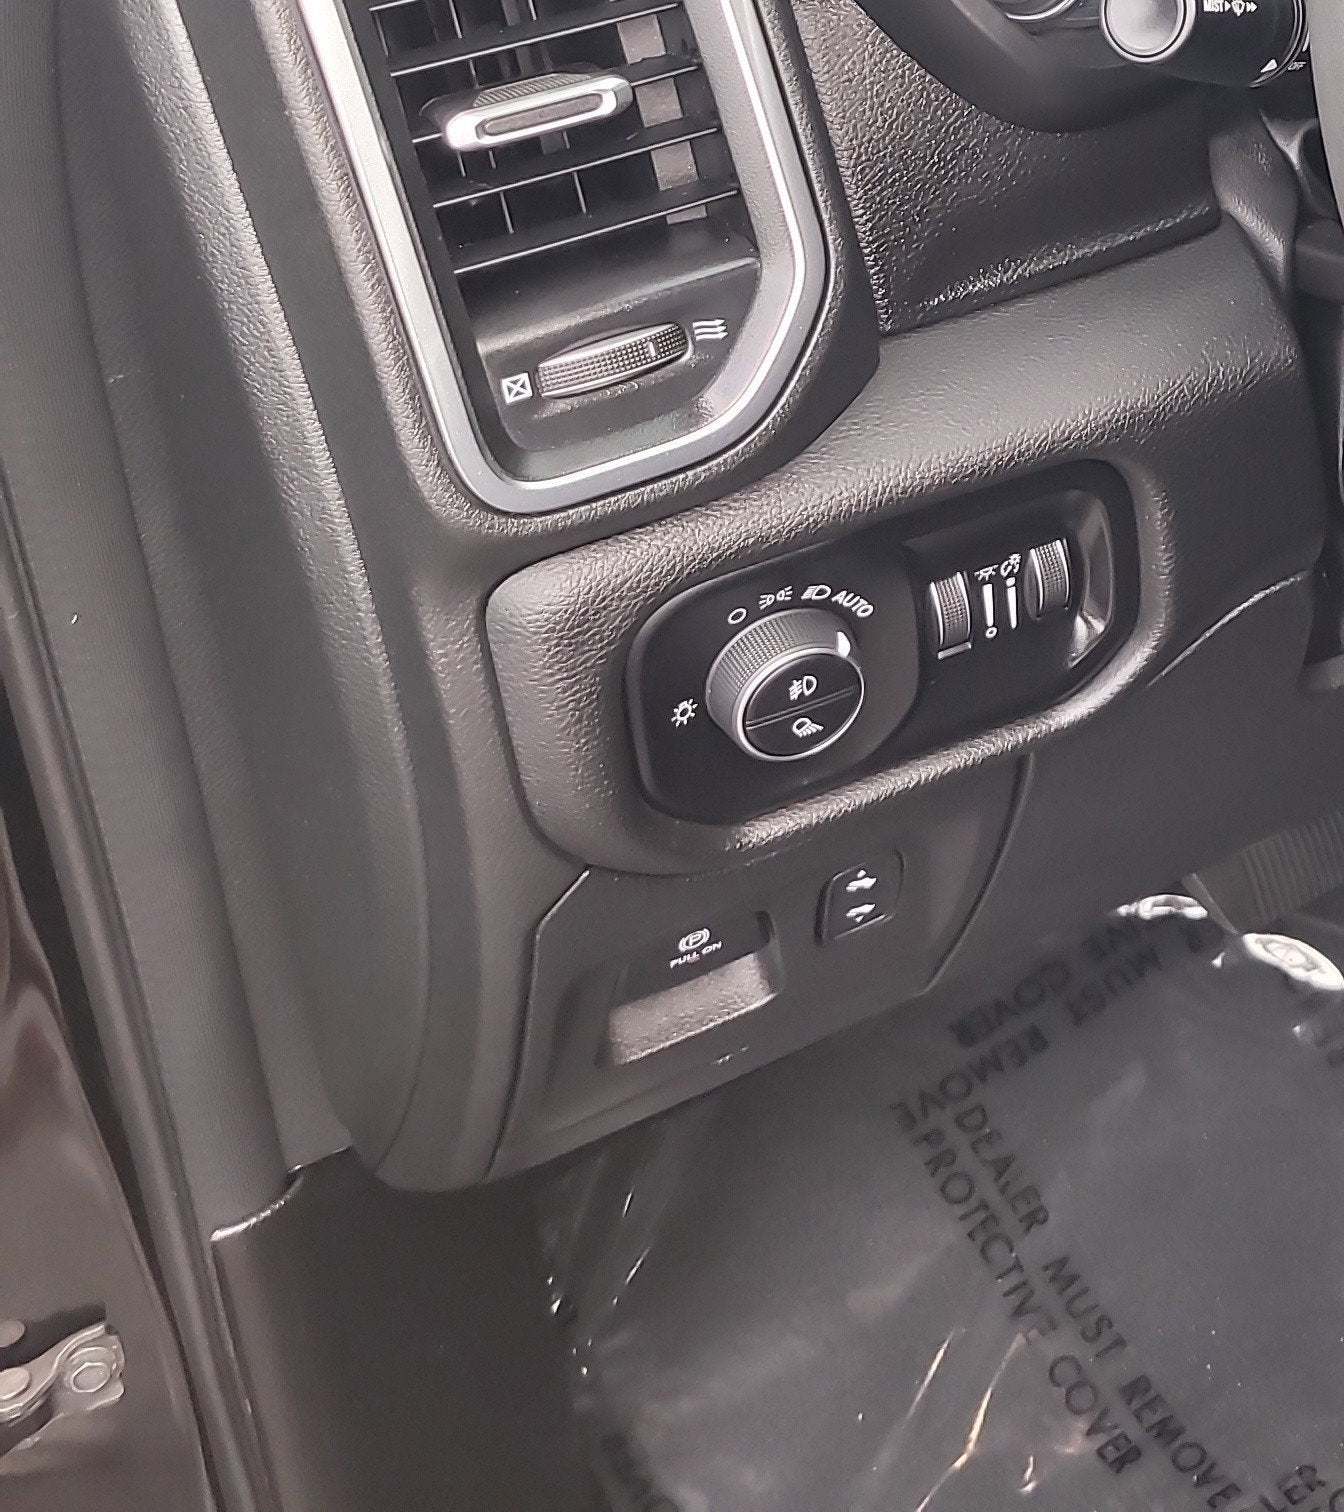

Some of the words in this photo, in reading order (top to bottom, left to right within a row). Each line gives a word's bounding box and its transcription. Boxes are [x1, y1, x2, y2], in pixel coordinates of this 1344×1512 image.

[831, 590, 874, 618] AUTO
[670, 951, 700, 969] PULL
[701, 941, 722, 955] ON
[913, 1128, 1058, 1337] PROTECTIVE
[1048, 1354, 1142, 1474] COVER
[954, 1105, 1050, 1235] DEALER
[1042, 1256, 1128, 1359] MUST
[1120, 1374, 1242, 1509] REMOVE
